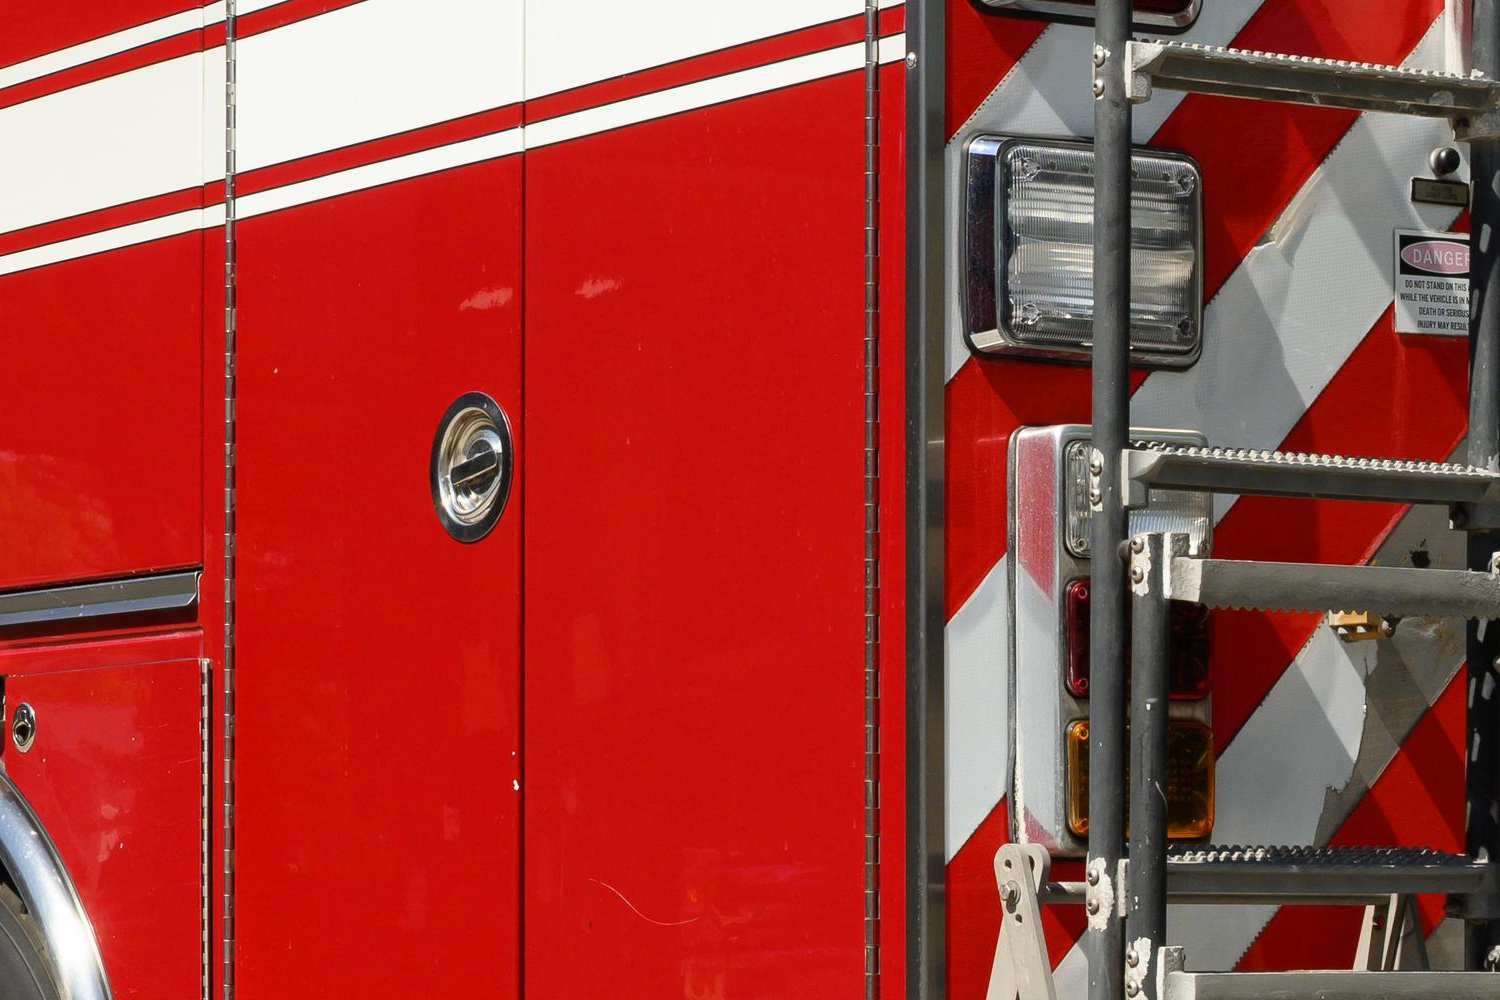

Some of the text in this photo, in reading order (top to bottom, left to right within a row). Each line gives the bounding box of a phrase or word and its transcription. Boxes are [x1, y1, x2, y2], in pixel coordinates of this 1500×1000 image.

[1405, 280, 1412, 288] DO
[1414, 280, 1425, 289] NOT
[1426, 281, 1444, 290] STAND
[1446, 282, 1453, 291] ON
[1454, 282, 1466, 292] THIS
[1400, 294, 1417, 302] WHILE
[1418, 294, 1429, 302] THE
[1429, 294, 1452, 304] VEHICLE
[1453, 296, 1458, 304] IS
[1459, 296, 1465, 304] IN
[1419, 308, 1469, 318] DEATH OR SERIOUS
[1417, 321, 1469, 330] INJURY MAY RESUL
